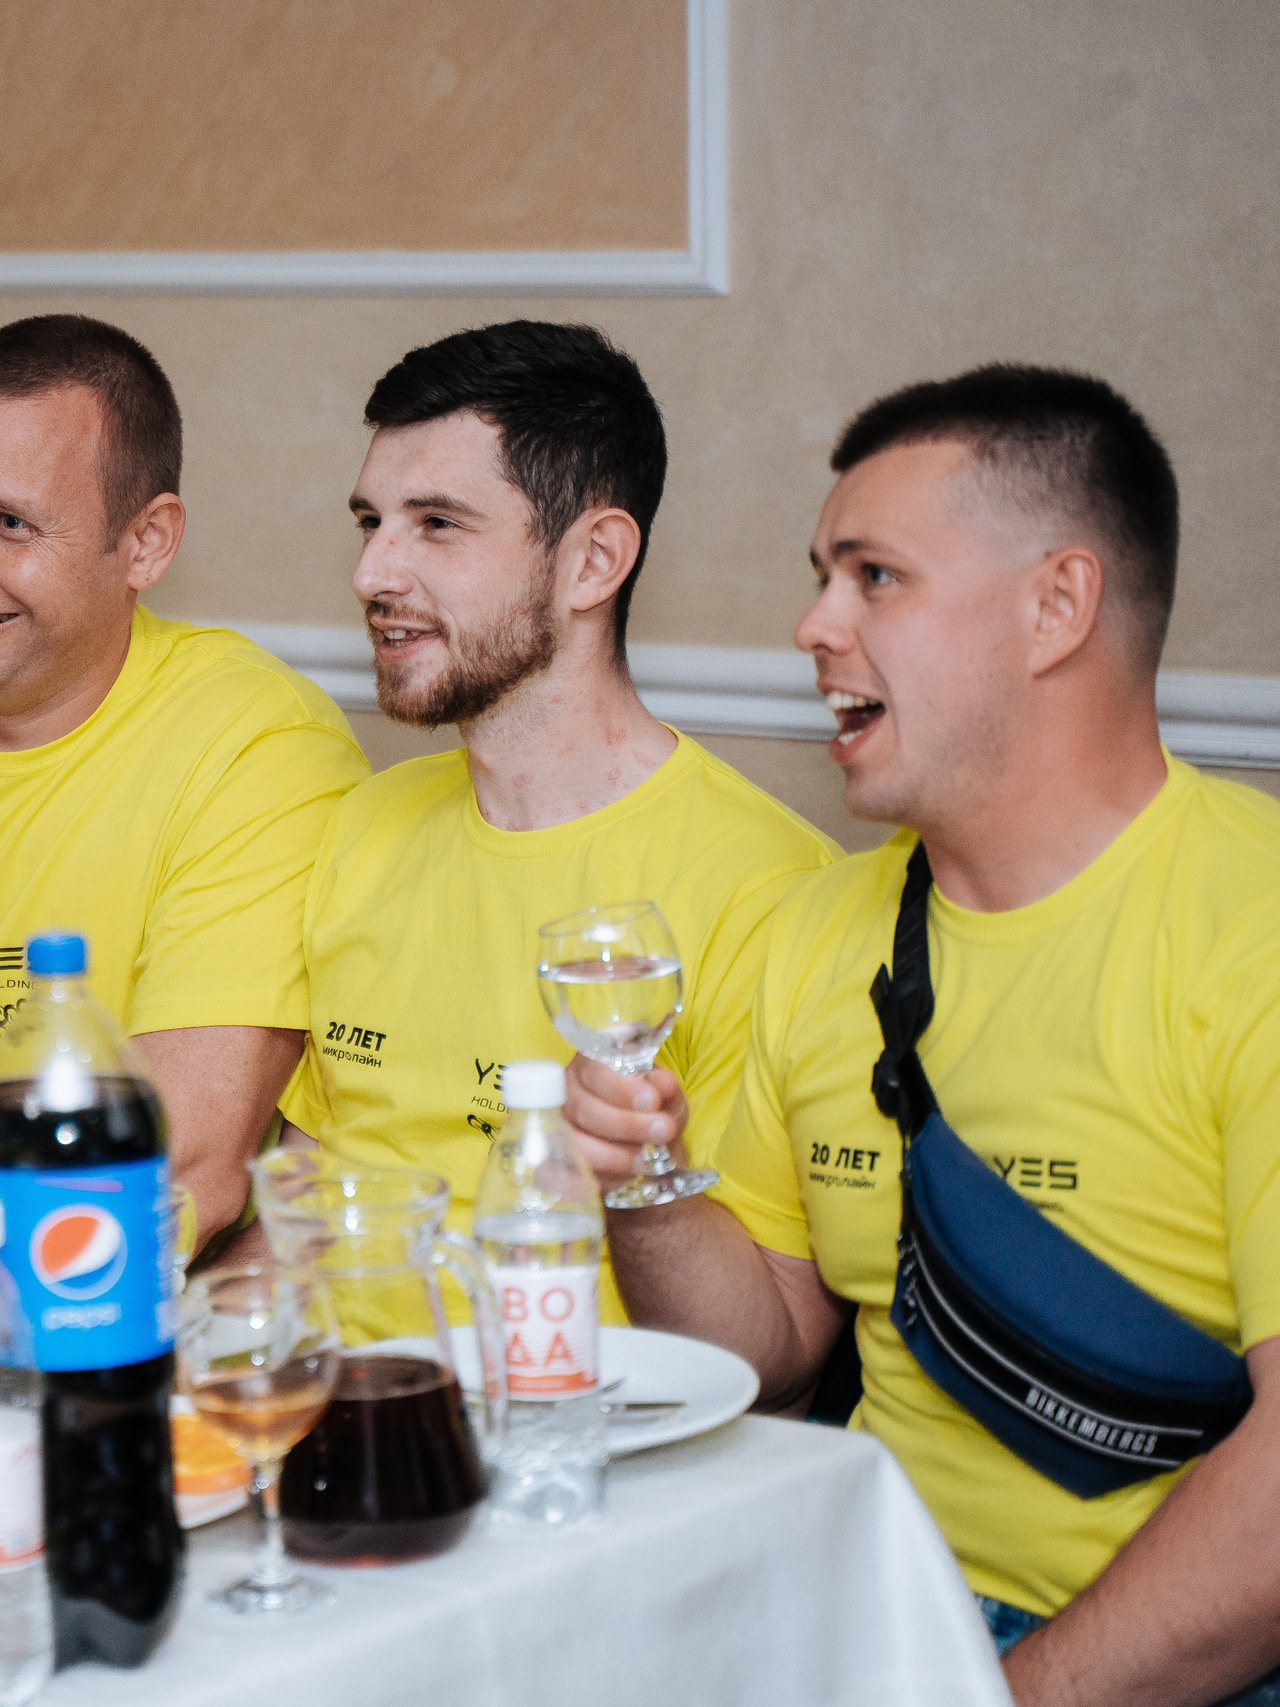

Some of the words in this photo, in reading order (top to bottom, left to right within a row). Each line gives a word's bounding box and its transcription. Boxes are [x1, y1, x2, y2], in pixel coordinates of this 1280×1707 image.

[326, 1021, 346, 1042] 20
[346, 1026, 387, 1052] ЛЕТ
[322, 1046, 382, 1069] микролайн
[811, 1142, 830, 1165] 20
[835, 1147, 881, 1172] ЛЕТ
[993, 1156, 1077, 1190] YES
